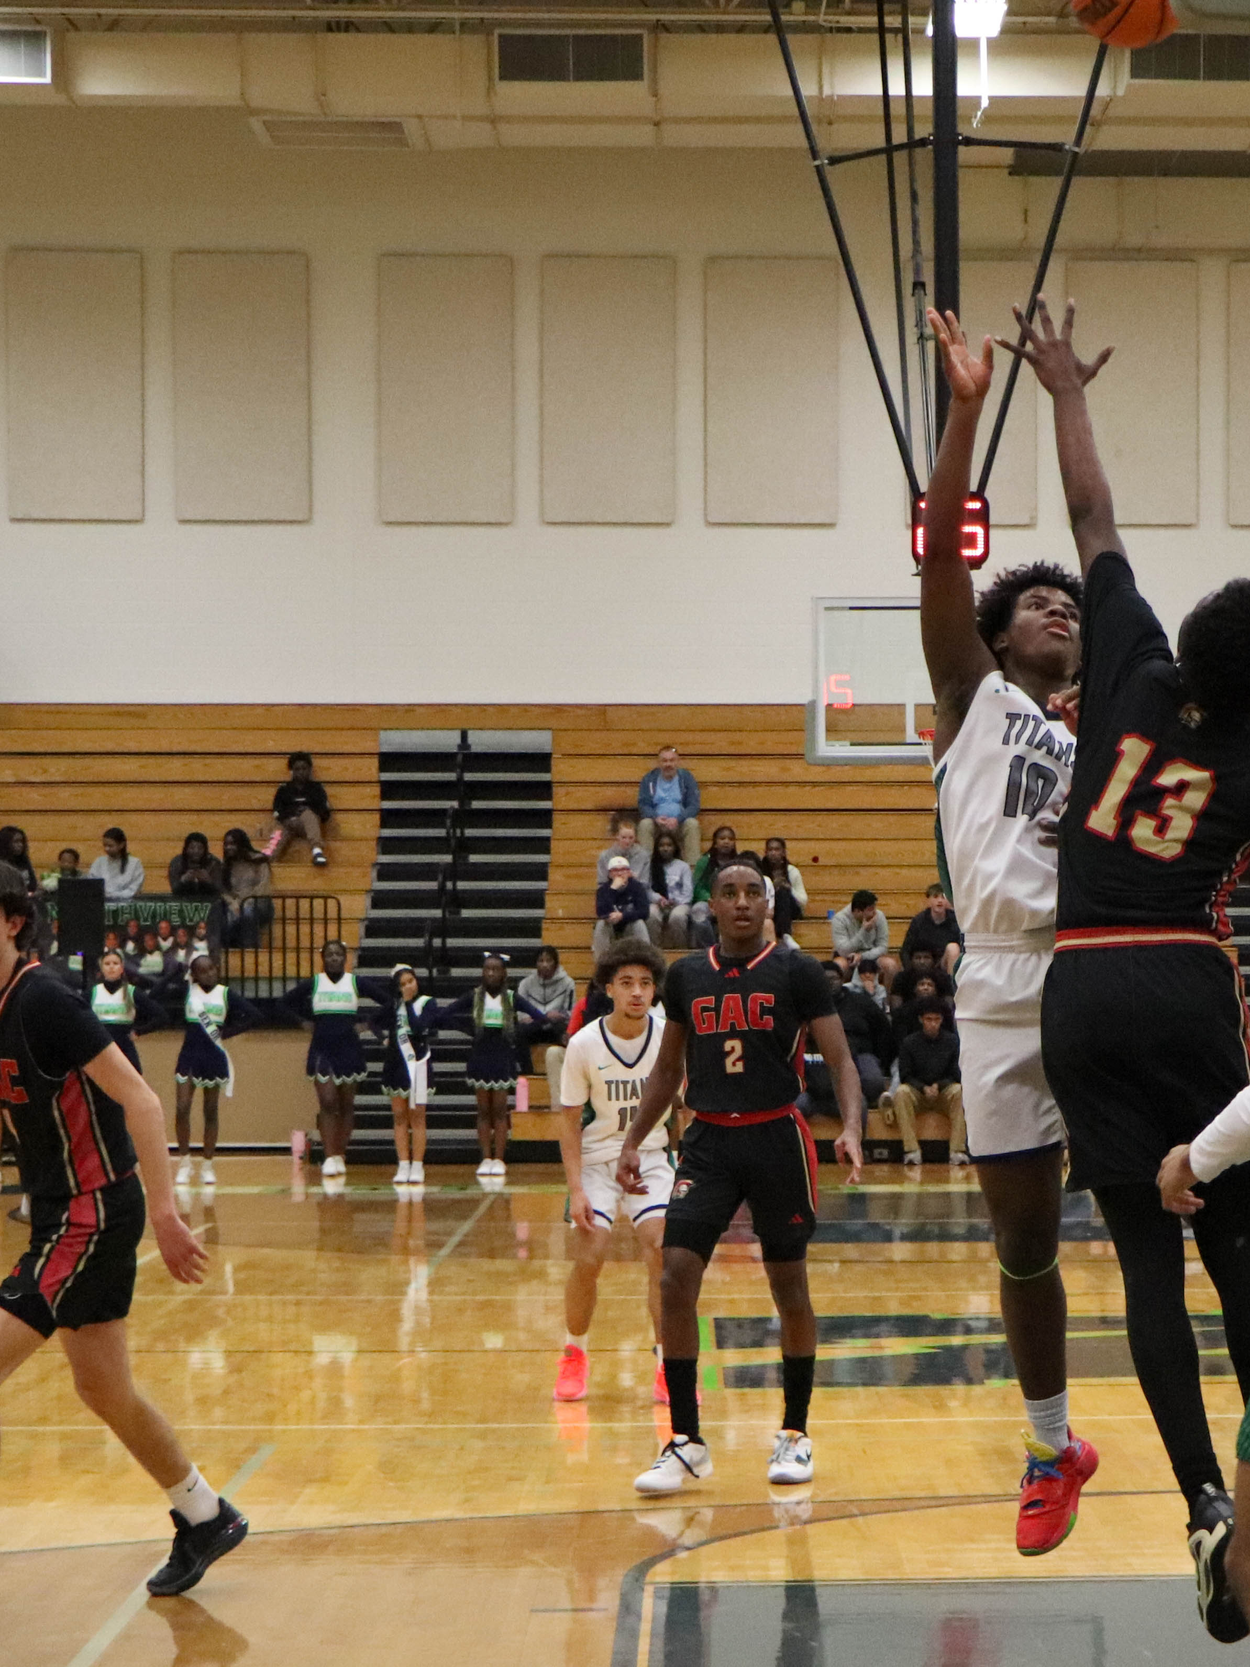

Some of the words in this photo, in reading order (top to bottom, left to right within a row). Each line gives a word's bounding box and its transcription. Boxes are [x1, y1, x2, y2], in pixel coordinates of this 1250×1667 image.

[1002, 712, 1075, 768] TITAN
[1003, 754, 1058, 821] 10
[1085, 733, 1217, 862] 13
[692, 994, 774, 1034] GAC
[723, 1038, 744, 1074] 2
